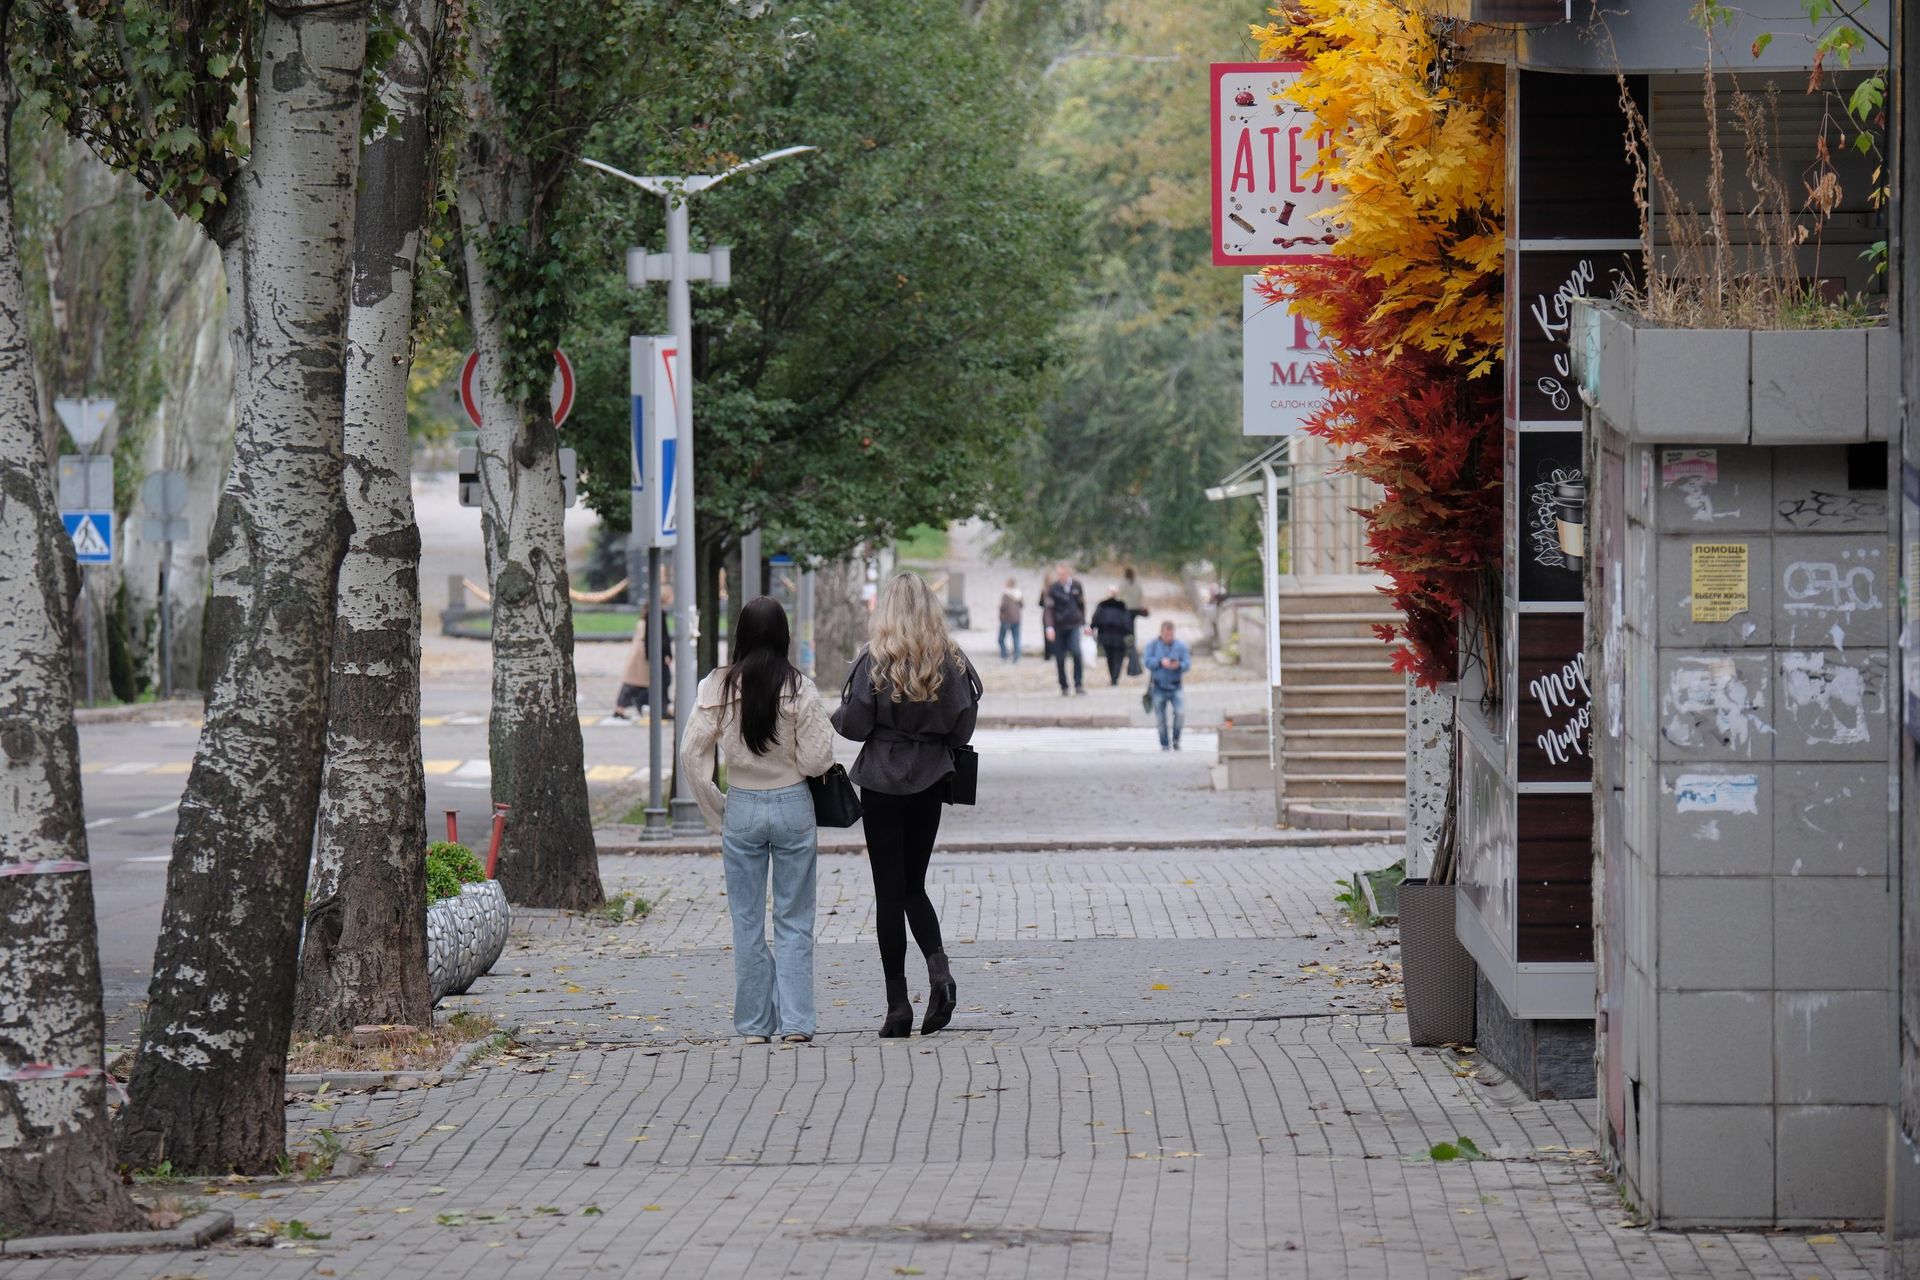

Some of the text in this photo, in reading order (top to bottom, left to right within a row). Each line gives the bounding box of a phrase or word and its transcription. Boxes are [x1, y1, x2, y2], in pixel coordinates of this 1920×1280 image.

[1230, 127, 1354, 193] АТЕЛ
[1270, 362, 1323, 386] МА
[1270, 400, 1306, 409] САЛОН
[1695, 546, 1746, 555] ПОМОЩЬ
[1695, 592, 1746, 600] ВЫБЕРИ ЖИЗНЬ
[1530, 652, 1592, 718] Мор
[1538, 701, 1592, 765] Пиро
